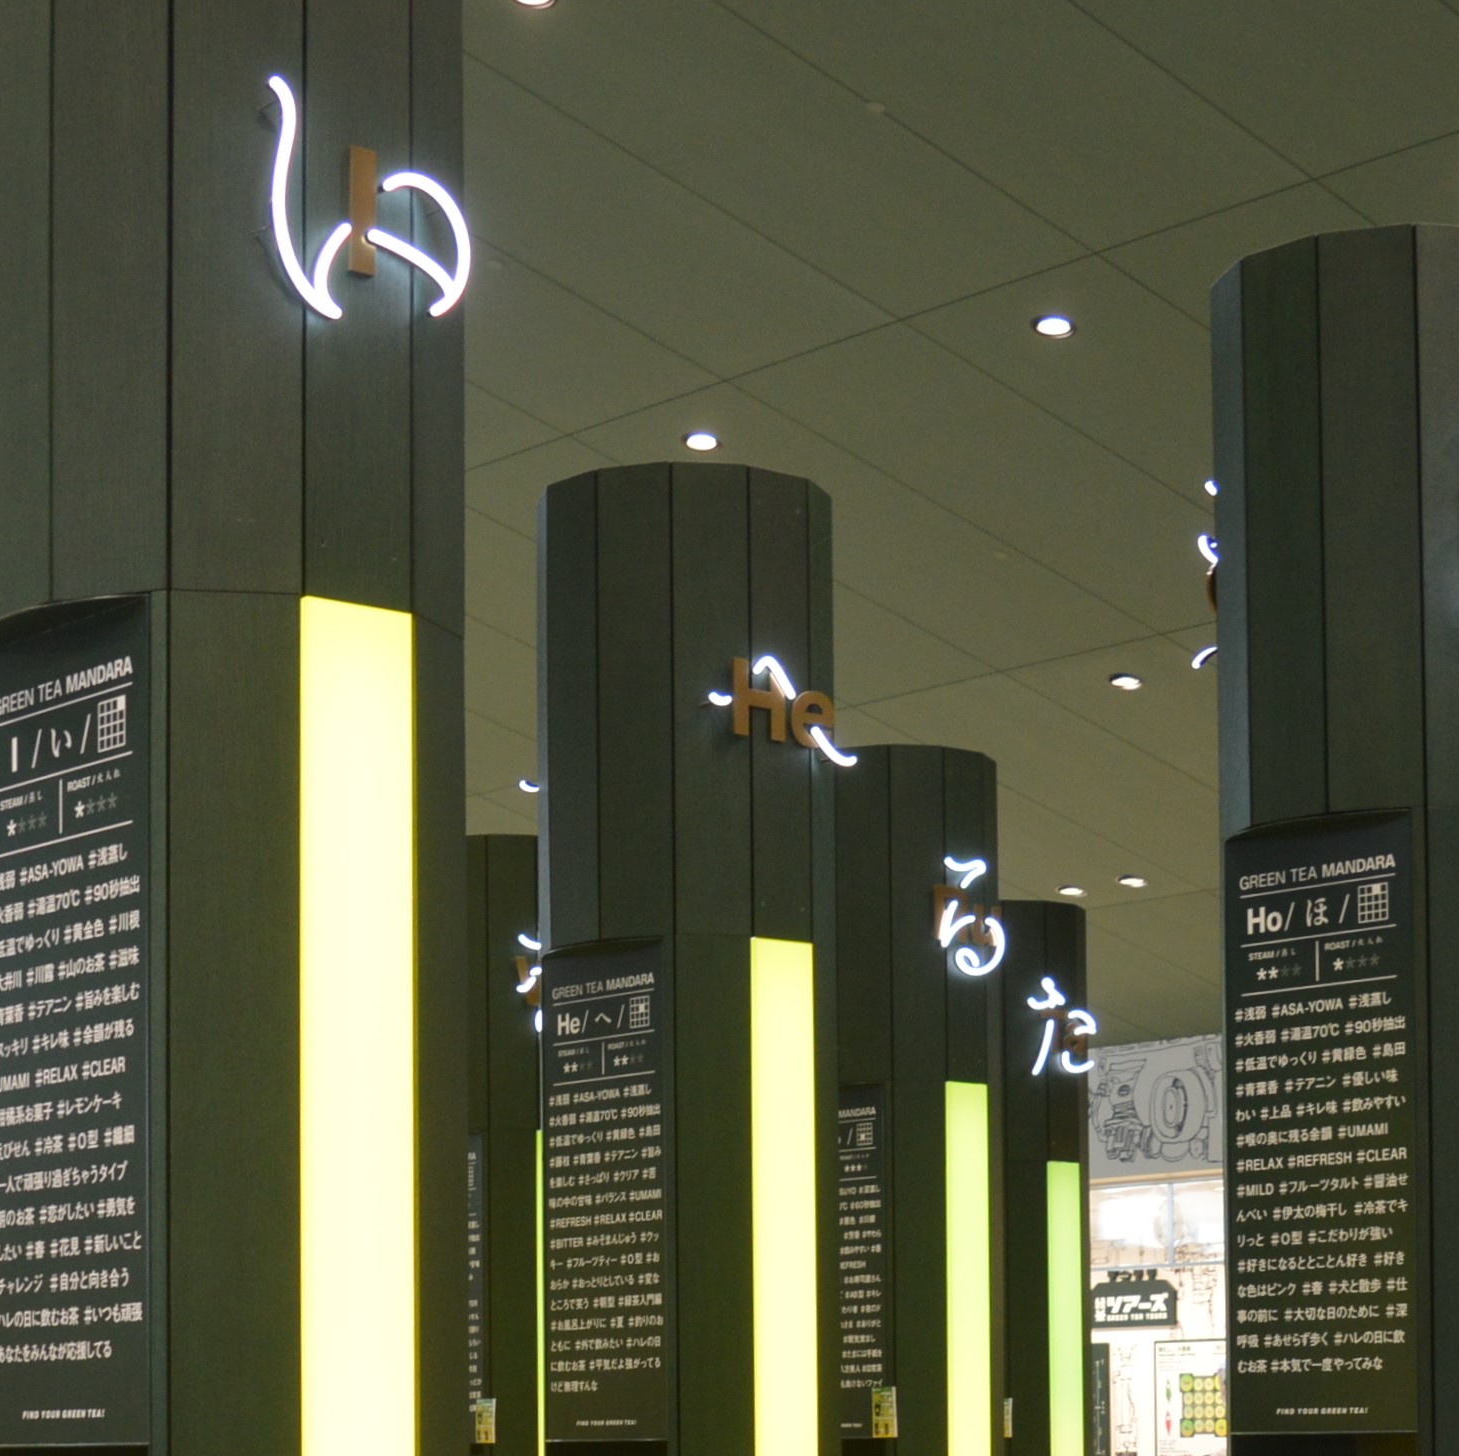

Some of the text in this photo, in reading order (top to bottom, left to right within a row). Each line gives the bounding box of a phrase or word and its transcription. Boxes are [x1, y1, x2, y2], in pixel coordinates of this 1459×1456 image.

[268, 74, 472, 321] い
[37, 679, 63, 703] TEA
[65, 656, 133, 694] MANDARA
[732, 657, 835, 749] He
[19, 854, 84, 886] #ASA-YOWA
[1239, 853, 1396, 891] GREEN TEA MANDARA
[941, 856, 1006, 977] る
[63, 918, 105, 944] #黄金色
[57, 952, 105, 980] #山のお茶
[551, 972, 655, 1000] GREEN TEA MANDARA
[27, 996, 72, 1020] #テアニン
[75, 981, 140, 1011] #旨みを楽しむ
[1271, 997, 1344, 1018] #ASA-YOWA
[1027, 976, 1098, 1077] た
[32, 1029, 70, 1054] #キレ味
[1235, 1051, 1317, 1073] #低温でゆっくり
[1372, 1041, 1406, 1059] #島田
[34, 1064, 78, 1087] #RELAX
[81, 1056, 126, 1080] #CLEAR
[1284, 1075, 1337, 1093] #テアニン
[1342, 1068, 1398, 1087] #優しい味
[56, 1091, 122, 1119] #レモンケーキ
[1235, 1094, 1406, 1122] わい #上品 #キレ味 #飲みやすい
[1337, 1122, 1389, 1139] #UMAMI
[34, 1134, 64, 1156] #冷茶
[1236, 1146, 1407, 1173] #RELAX #REFRESH #CLEAR
[629, 1188, 662, 1203] #UMAMI
[1236, 1182, 1275, 1198] #MILD
[1278, 1176, 1359, 1195] #フルーツタルト
[96, 1195, 136, 1219] #勇気を
[550, 1209, 663, 1229] #REFRESH #RELAX #CLEAR
[1236, 1208, 1268, 1222] んべい
[1353, 1198, 1409, 1216] #冷茶でキ
[25, 1240, 45, 1260] #春
[49, 1236, 81, 1258] #花見
[84, 1230, 142, 1255] #新しいこと
[1307, 1226, 1393, 1244] #こだわりが強い
[1237, 1251, 1405, 1273] #好きになるととことん好き #好き
[49, 1267, 129, 1292] #自分と向き合う
[1302, 1280, 1323, 1296] #春
[1328, 1278, 1382, 1294] #犬と散歩
[1386, 1276, 1408, 1292] #仕
[1106, 1291, 1170, 1314] ツアーズ
[1283, 1305, 1380, 1322] #大切な日のために
[1263, 1331, 1328, 1348] #あせらず歩く
[1333, 1329, 1405, 1346] #ハレの日に飲
[1237, 1356, 1383, 1374] むお茶 #本気で一度やってみな
